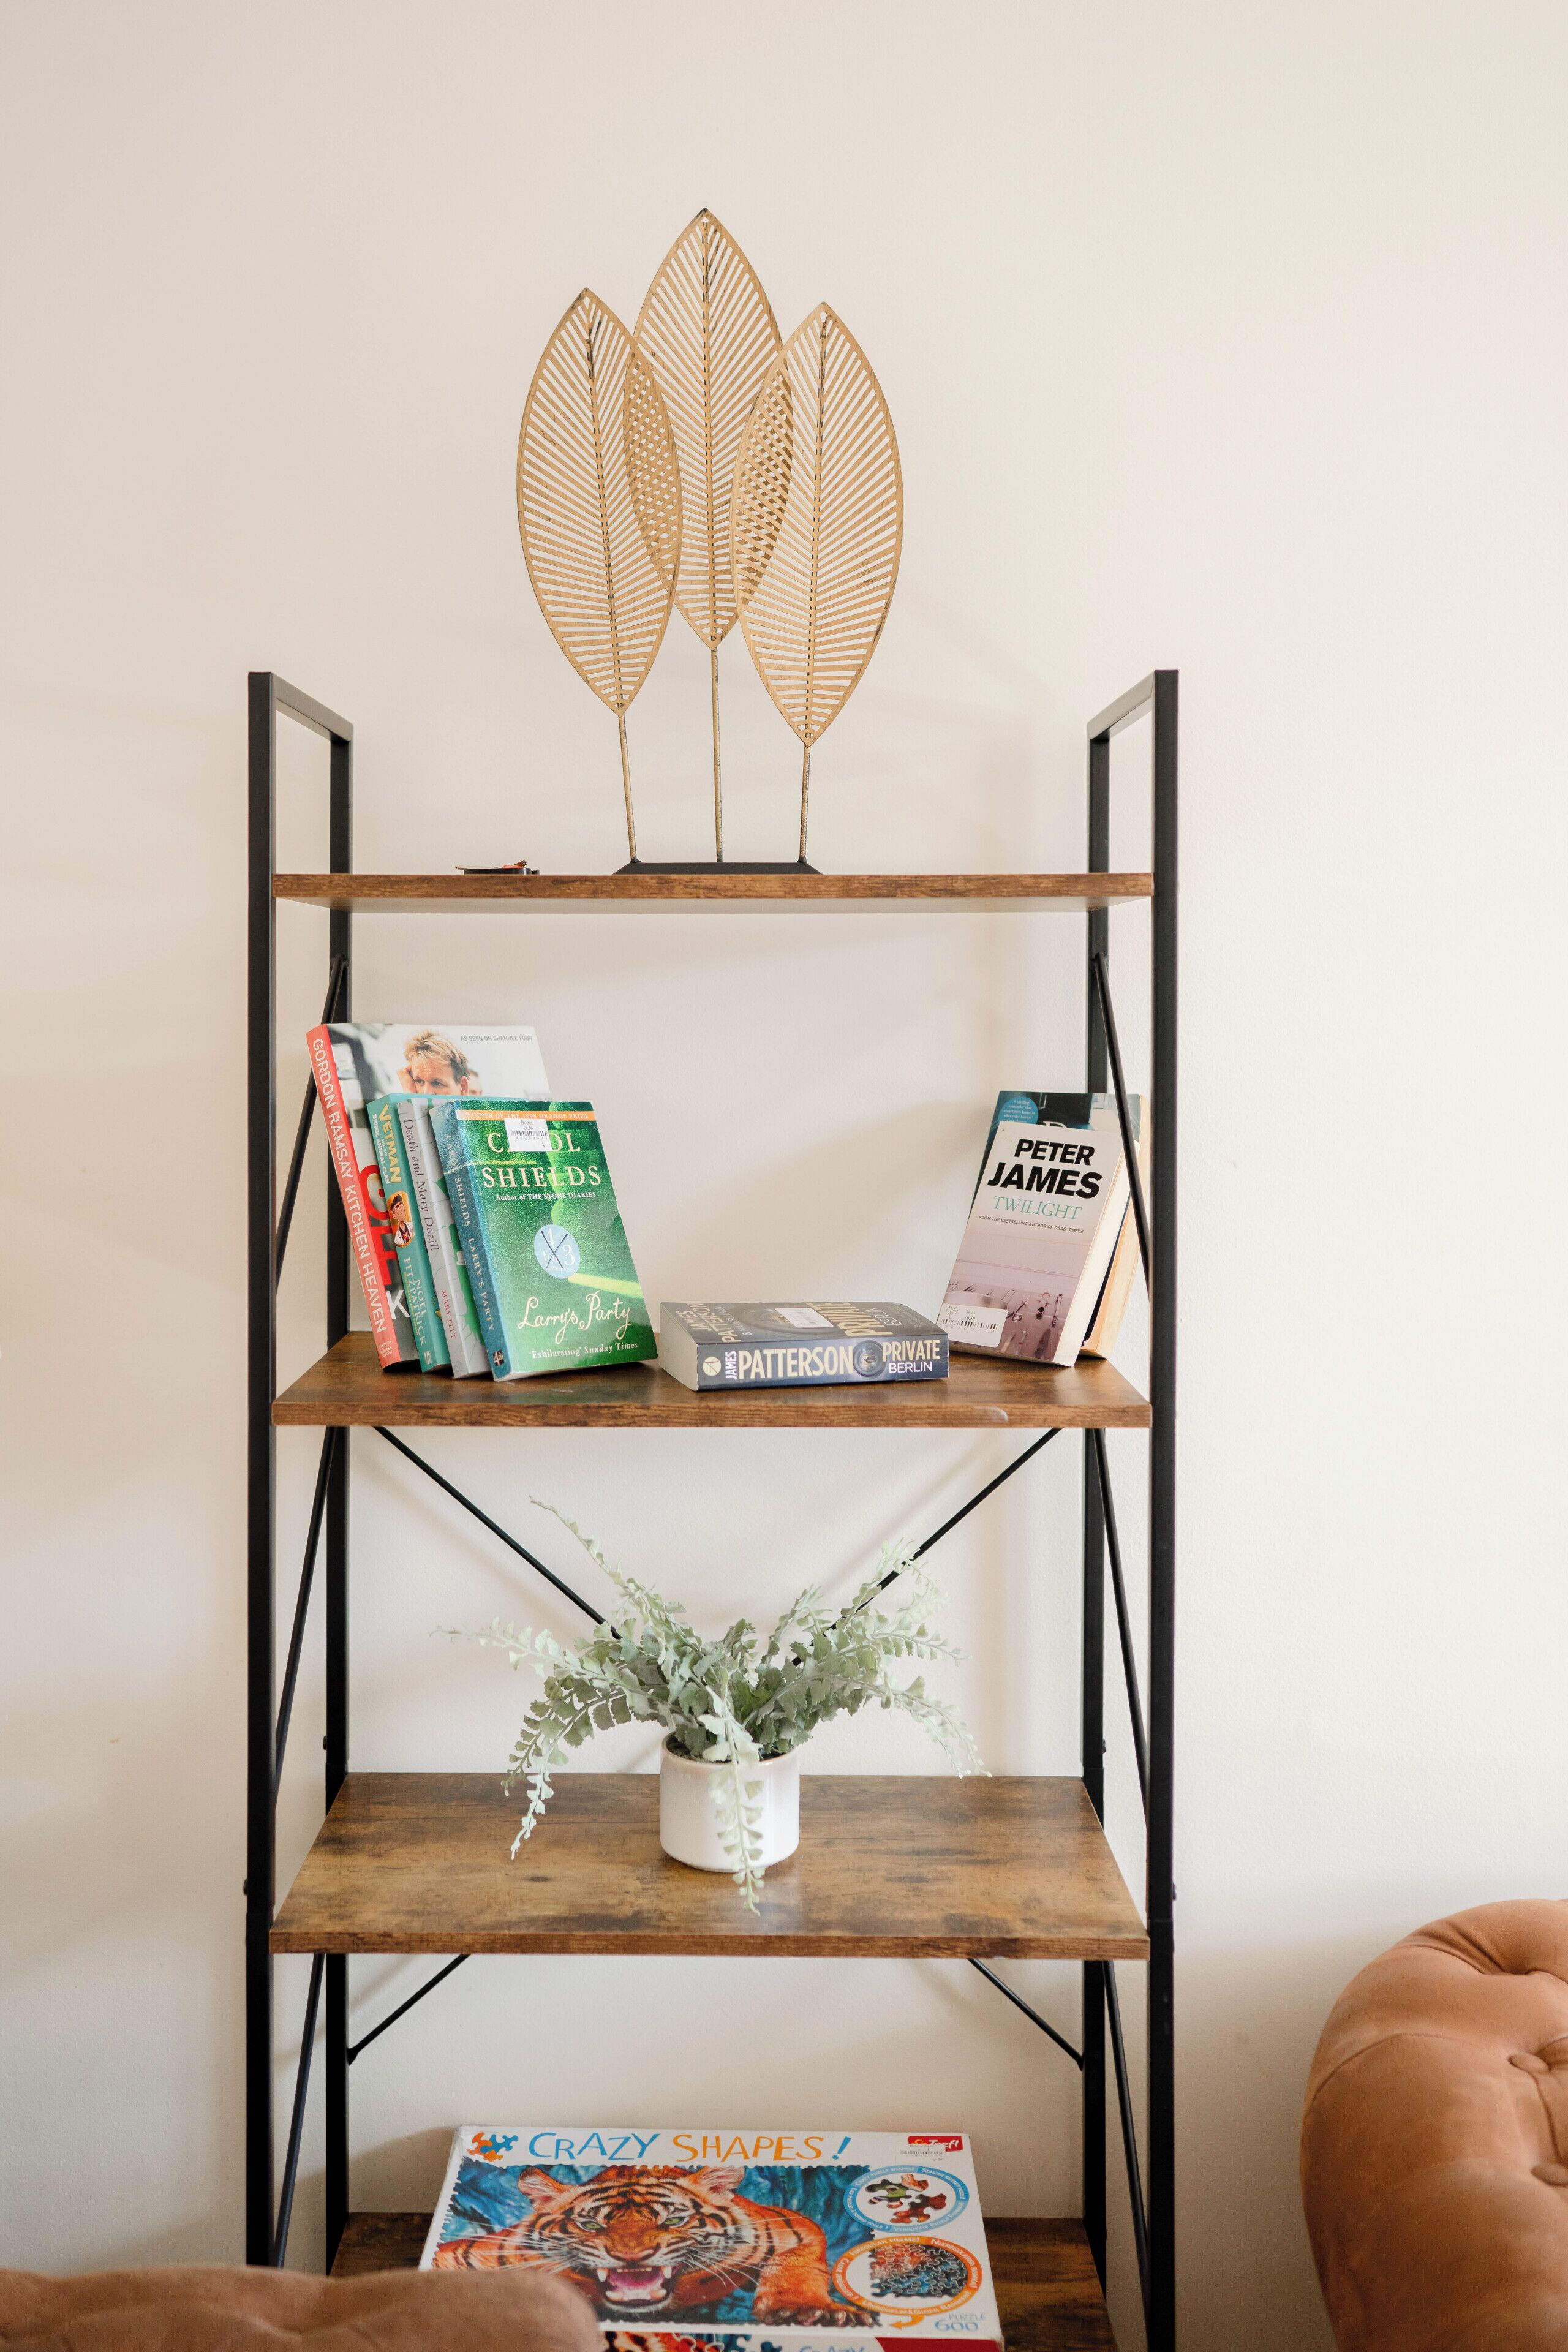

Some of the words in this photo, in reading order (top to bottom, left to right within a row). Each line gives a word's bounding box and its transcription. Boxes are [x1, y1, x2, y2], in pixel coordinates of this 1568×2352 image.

[379, 1104, 402, 1183] VETMAN
[404, 1119, 418, 1152] Death
[488, 1133, 581, 1153] COL
[376, 1139, 385, 1166] ANIMAL
[412, 1156, 423, 1176] and
[1014, 1139, 1095, 1166] PETER
[313, 1038, 337, 1109] GORDON
[328, 1111, 353, 1178] RAMSAY
[345, 1185, 371, 1259] KITCHEN
[363, 1263, 386, 1333] HEAVEN
[482, 1166, 601, 1188] SHIELDS
[987, 1161, 1103, 1199] JAMES
[417, 1181, 429, 1212] Mary
[993, 1196, 1083, 1219] TWILIGHT
[424, 1216, 439, 1251] Dazill
[455, 1177, 471, 1226] SHIELDS
[468, 1237, 484, 1287] LARRY'S
[481, 1292, 495, 1330] PARTY
[562, 1244, 575, 1265] 3
[404, 1257, 426, 1346] FITZPATRICK
[415, 1279, 427, 1317] NOEL
[441, 1289, 451, 1316] MARY
[518, 1297, 578, 1344] Larry's
[578, 1290, 633, 1340] Party
[676, 1310, 712, 1331] JAMES
[686, 1303, 742, 1343] PATTERSON
[805, 1302, 894, 1337] PRIVATE
[862, 1307, 903, 1325] BERLIN
[584, 1344, 612, 1354] Sunday
[615, 1342, 638, 1351] Times
[882, 1340, 940, 1362] PRIVATE
[725, 1351, 737, 1379] JAMES
[738, 1346, 854, 1379] PATTERSON
[889, 1362, 932, 1373] BERLIN
[528, 2132, 660, 2160] CRAZY
